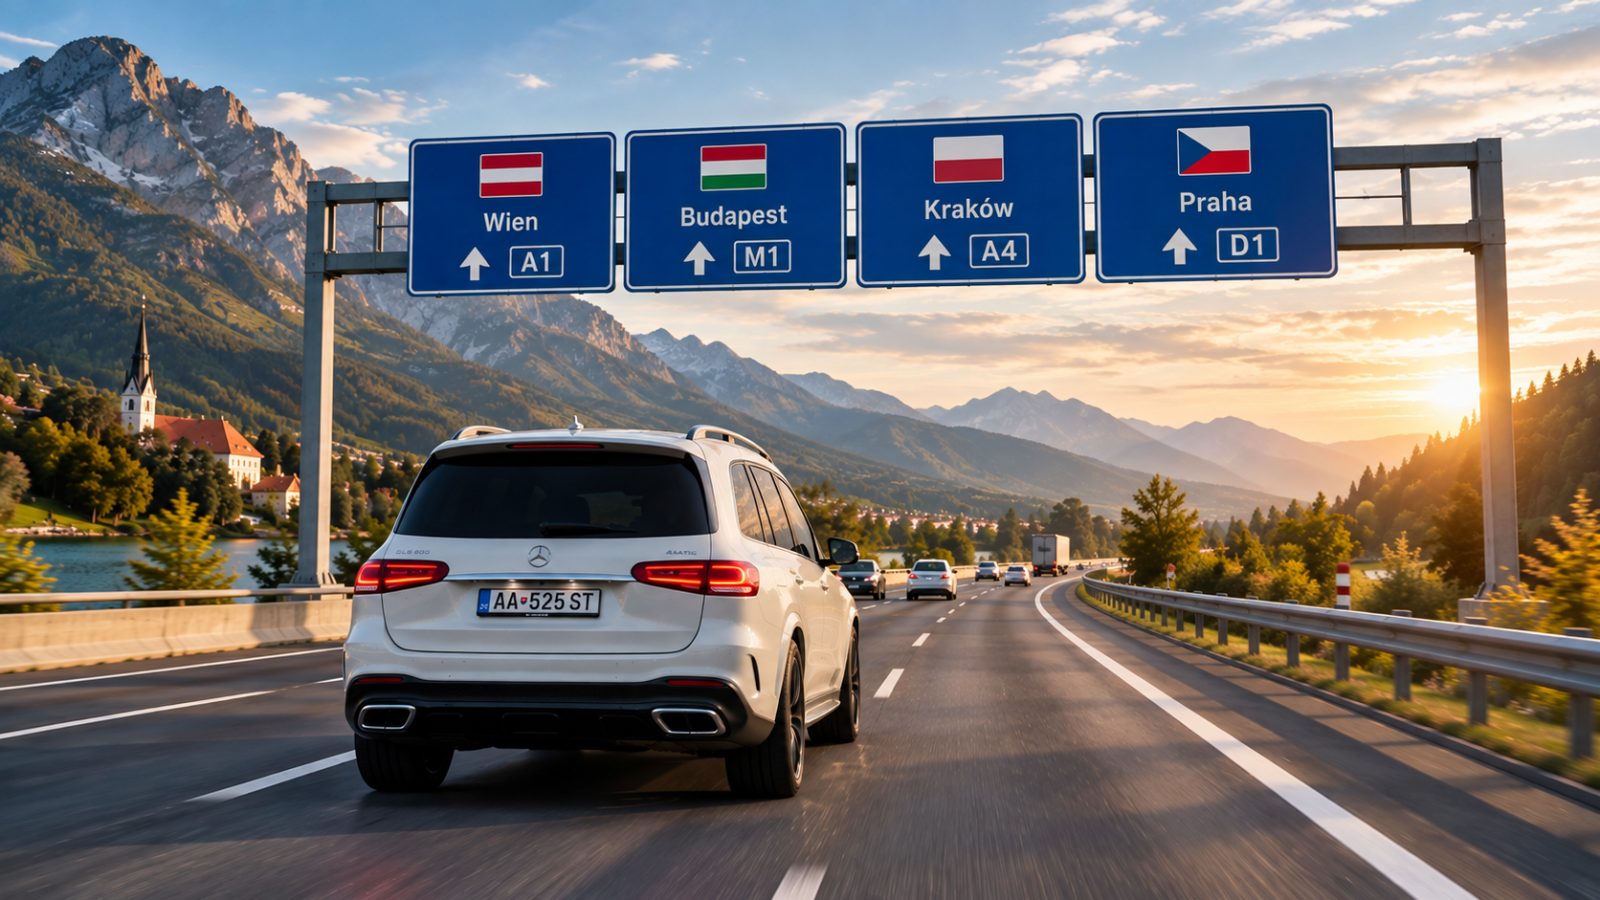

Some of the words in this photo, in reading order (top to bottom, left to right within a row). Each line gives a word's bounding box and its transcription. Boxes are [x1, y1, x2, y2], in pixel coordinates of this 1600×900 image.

[924, 197, 1014, 220] Kraków
[1180, 190, 1252, 213] Praha
[484, 211, 538, 232] Wien
[681, 205, 788, 229] Budapest
[981, 240, 1017, 262] A4
[1230, 234, 1263, 257] D1
[521, 251, 549, 273] A1
[745, 246, 778, 268] M1
[493, 592, 518, 610] AA
[529, 592, 565, 610] 525
[569, 592, 594, 610] ST
